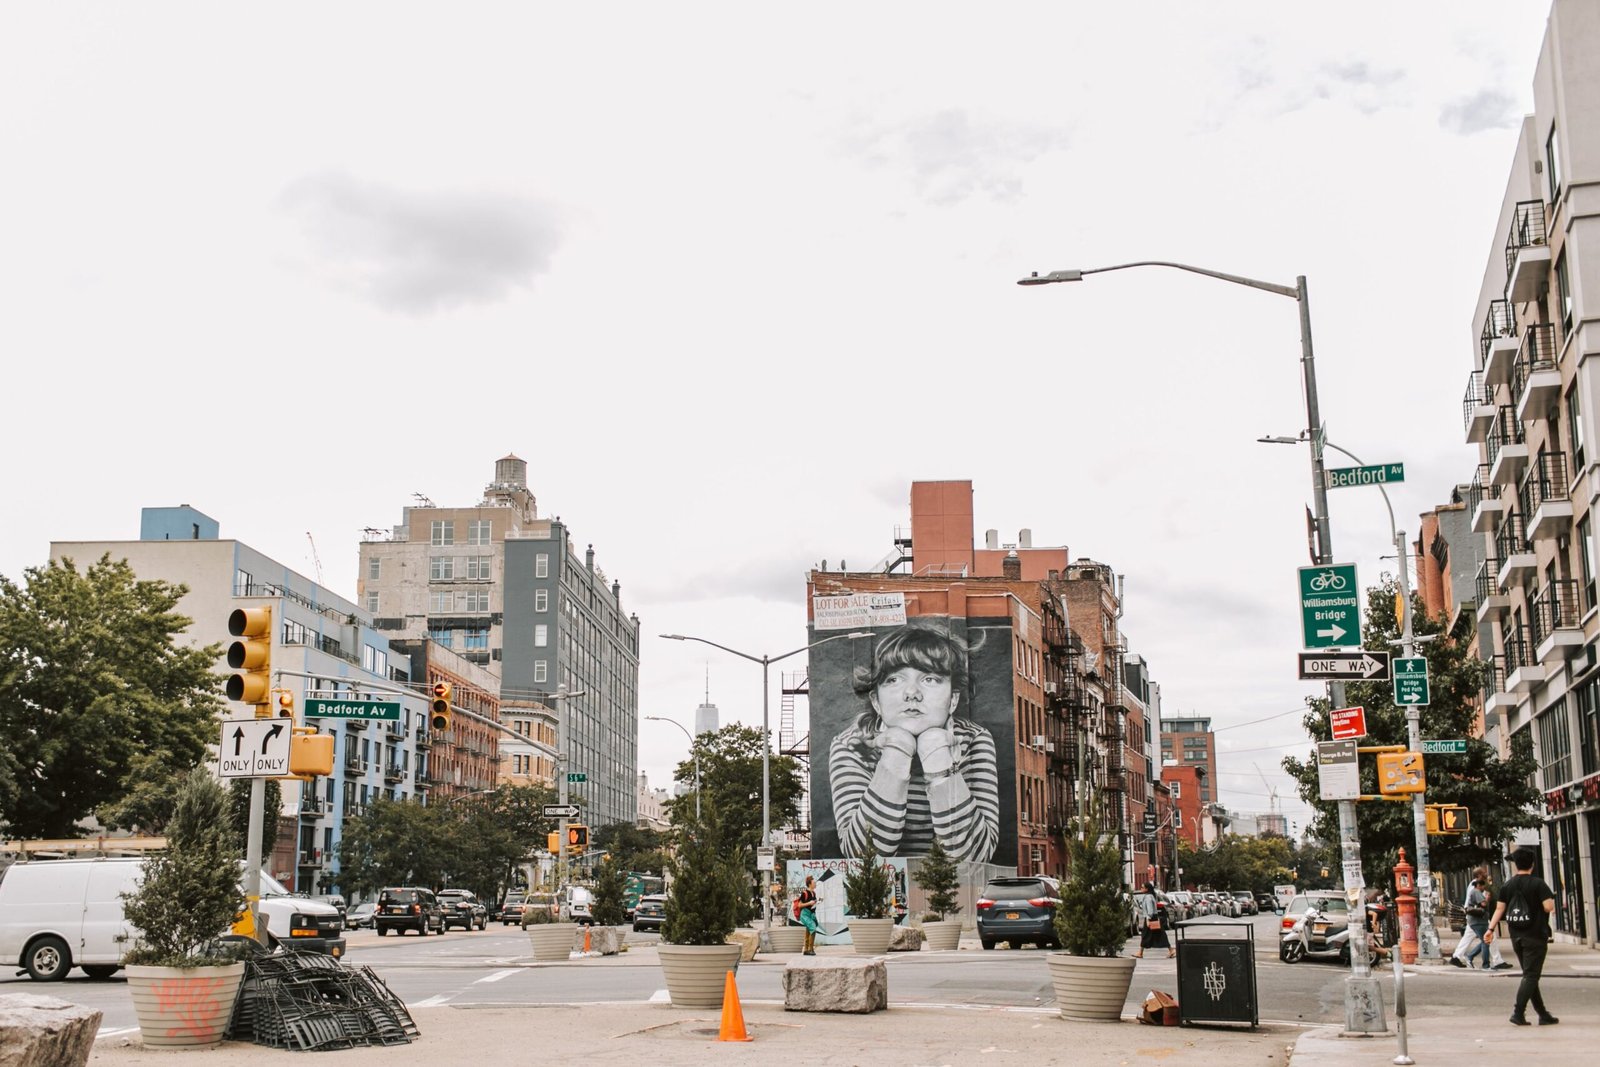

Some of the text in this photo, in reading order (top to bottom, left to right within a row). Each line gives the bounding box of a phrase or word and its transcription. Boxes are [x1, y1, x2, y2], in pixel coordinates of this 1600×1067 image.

[1330, 465, 1402, 487] Bedford Av
[816, 598, 831, 610] LOT
[833, 597, 849, 609] FOR
[1303, 597, 1357, 608] Williamsburg
[1315, 611, 1346, 621] Bridge
[1311, 661, 1375, 672] ONE WAY
[318, 703, 387, 716] Bedford Av
[1338, 710, 1359, 719] STANDING
[1423, 741, 1455, 752] Bedford
[223, 759, 250, 771] ONLY
[257, 758, 284, 770] ONLY
